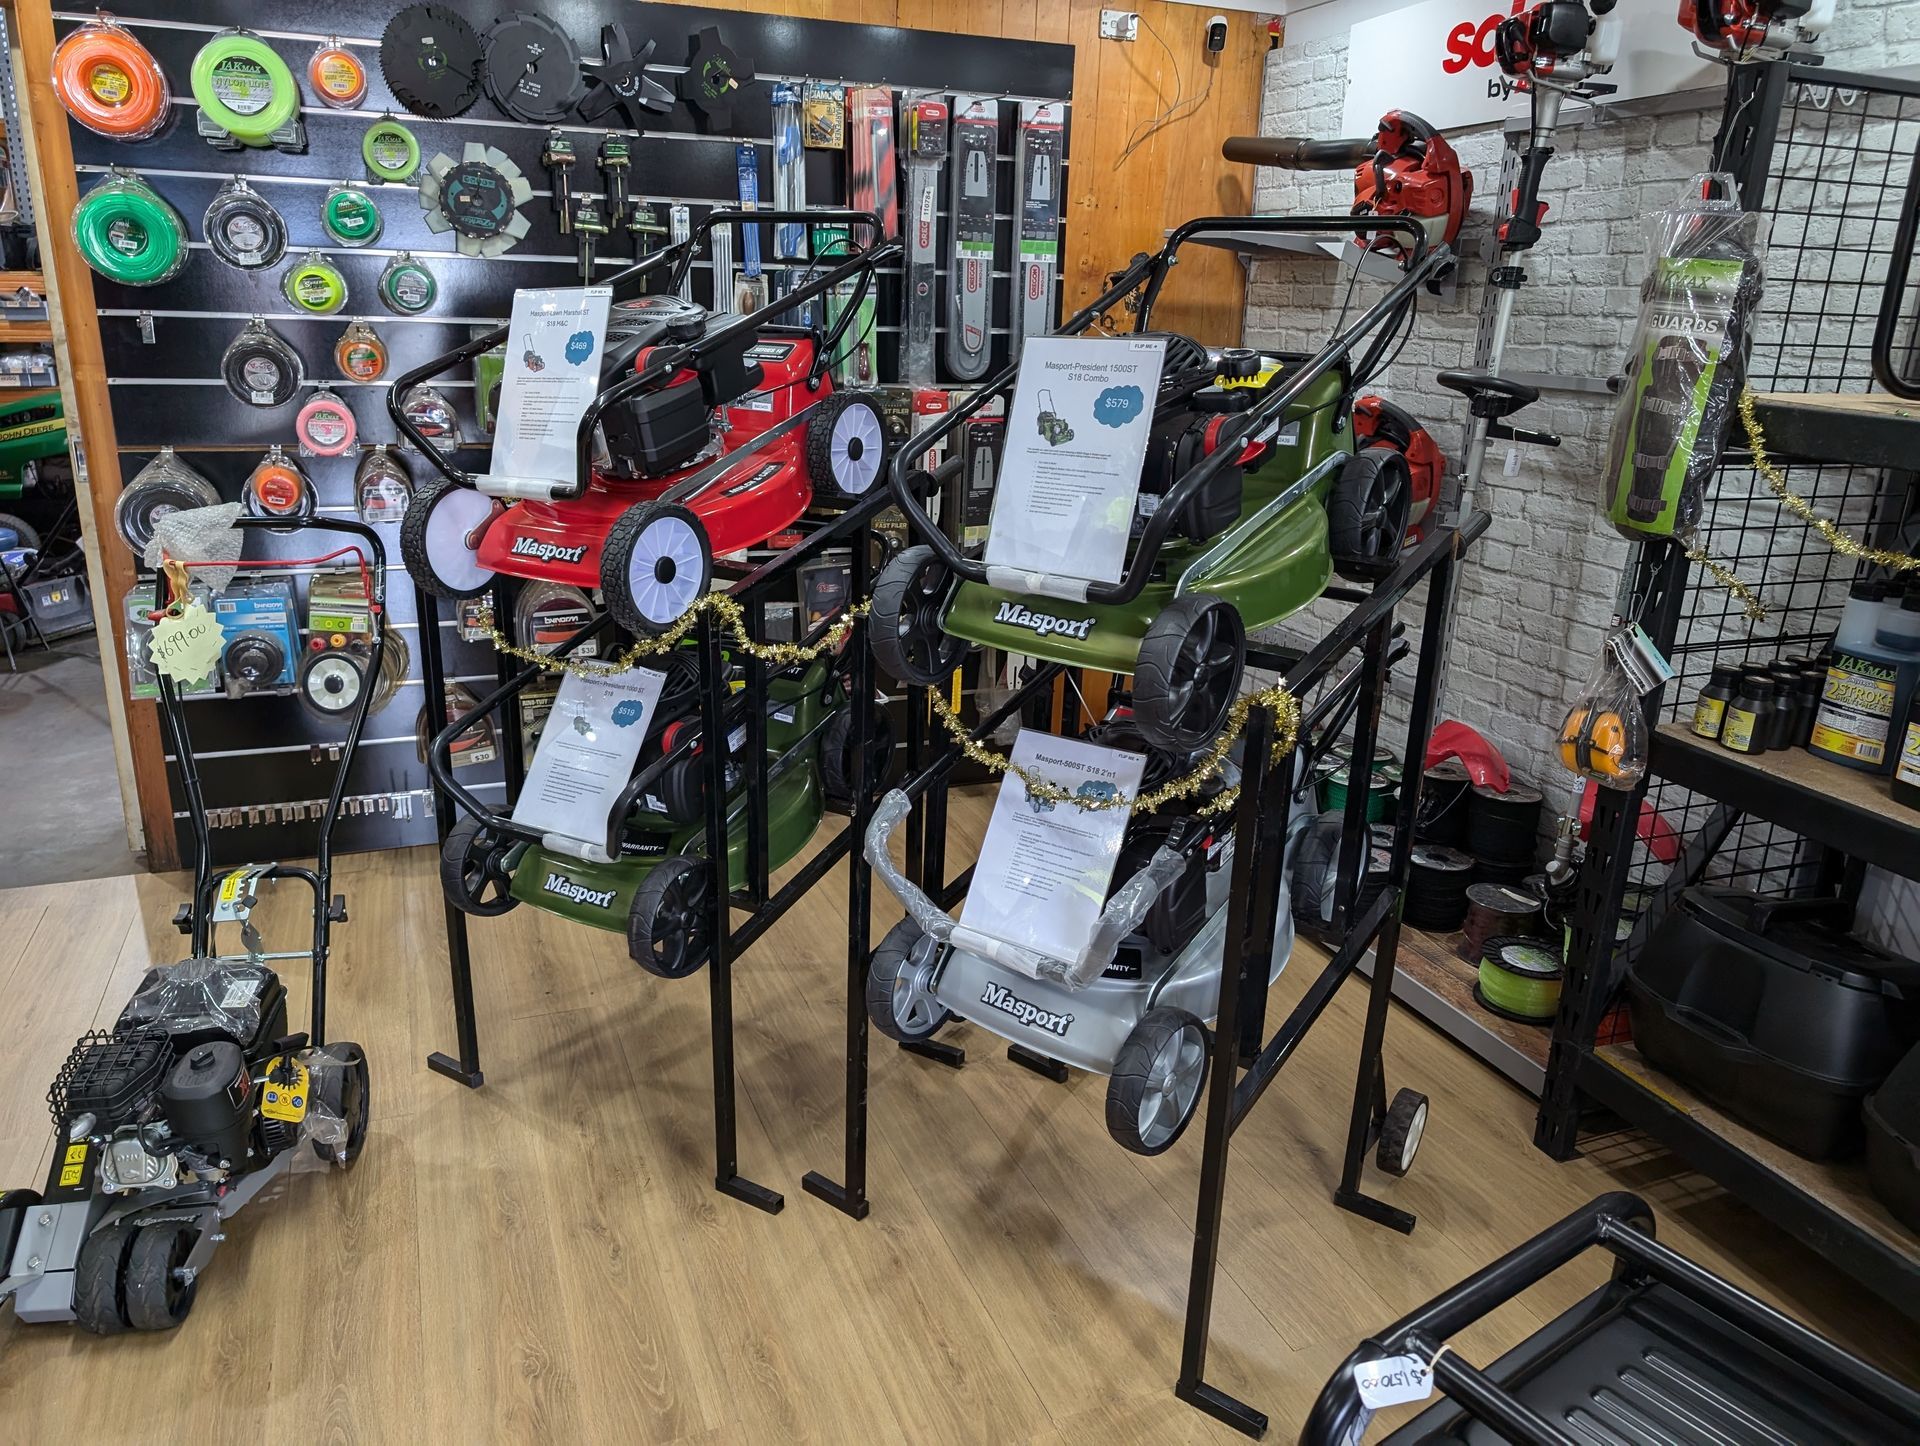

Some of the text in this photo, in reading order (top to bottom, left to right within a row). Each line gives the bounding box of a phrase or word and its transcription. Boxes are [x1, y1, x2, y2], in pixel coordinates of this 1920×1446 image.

[220, 60, 261, 73] JAKMAX
[1487, 78, 1513, 101] by
[923, 190, 932, 216] 110784
[1651, 314, 1719, 333] GUARDS
[570, 341, 587, 350] $469
[1045, 361, 1138, 373] Masport-President 1500ST
[1067, 373, 1109, 382] S18 Combo
[1105, 397, 1129, 409] $579
[24, 424, 54, 435] DEERE
[511, 537, 583, 562] Masport
[994, 602, 1090, 637] Masport
[157, 624, 206, 662] $699.00
[1835, 654, 1897, 680] JAKMAX
[618, 706, 635, 716] $519
[474, 753, 490, 761] $30
[1035, 753, 1086, 771] Masport-500ST
[1086, 765, 1100, 775] S18
[544, 873, 613, 907] Masport
[982, 983, 1071, 1034] Masport
